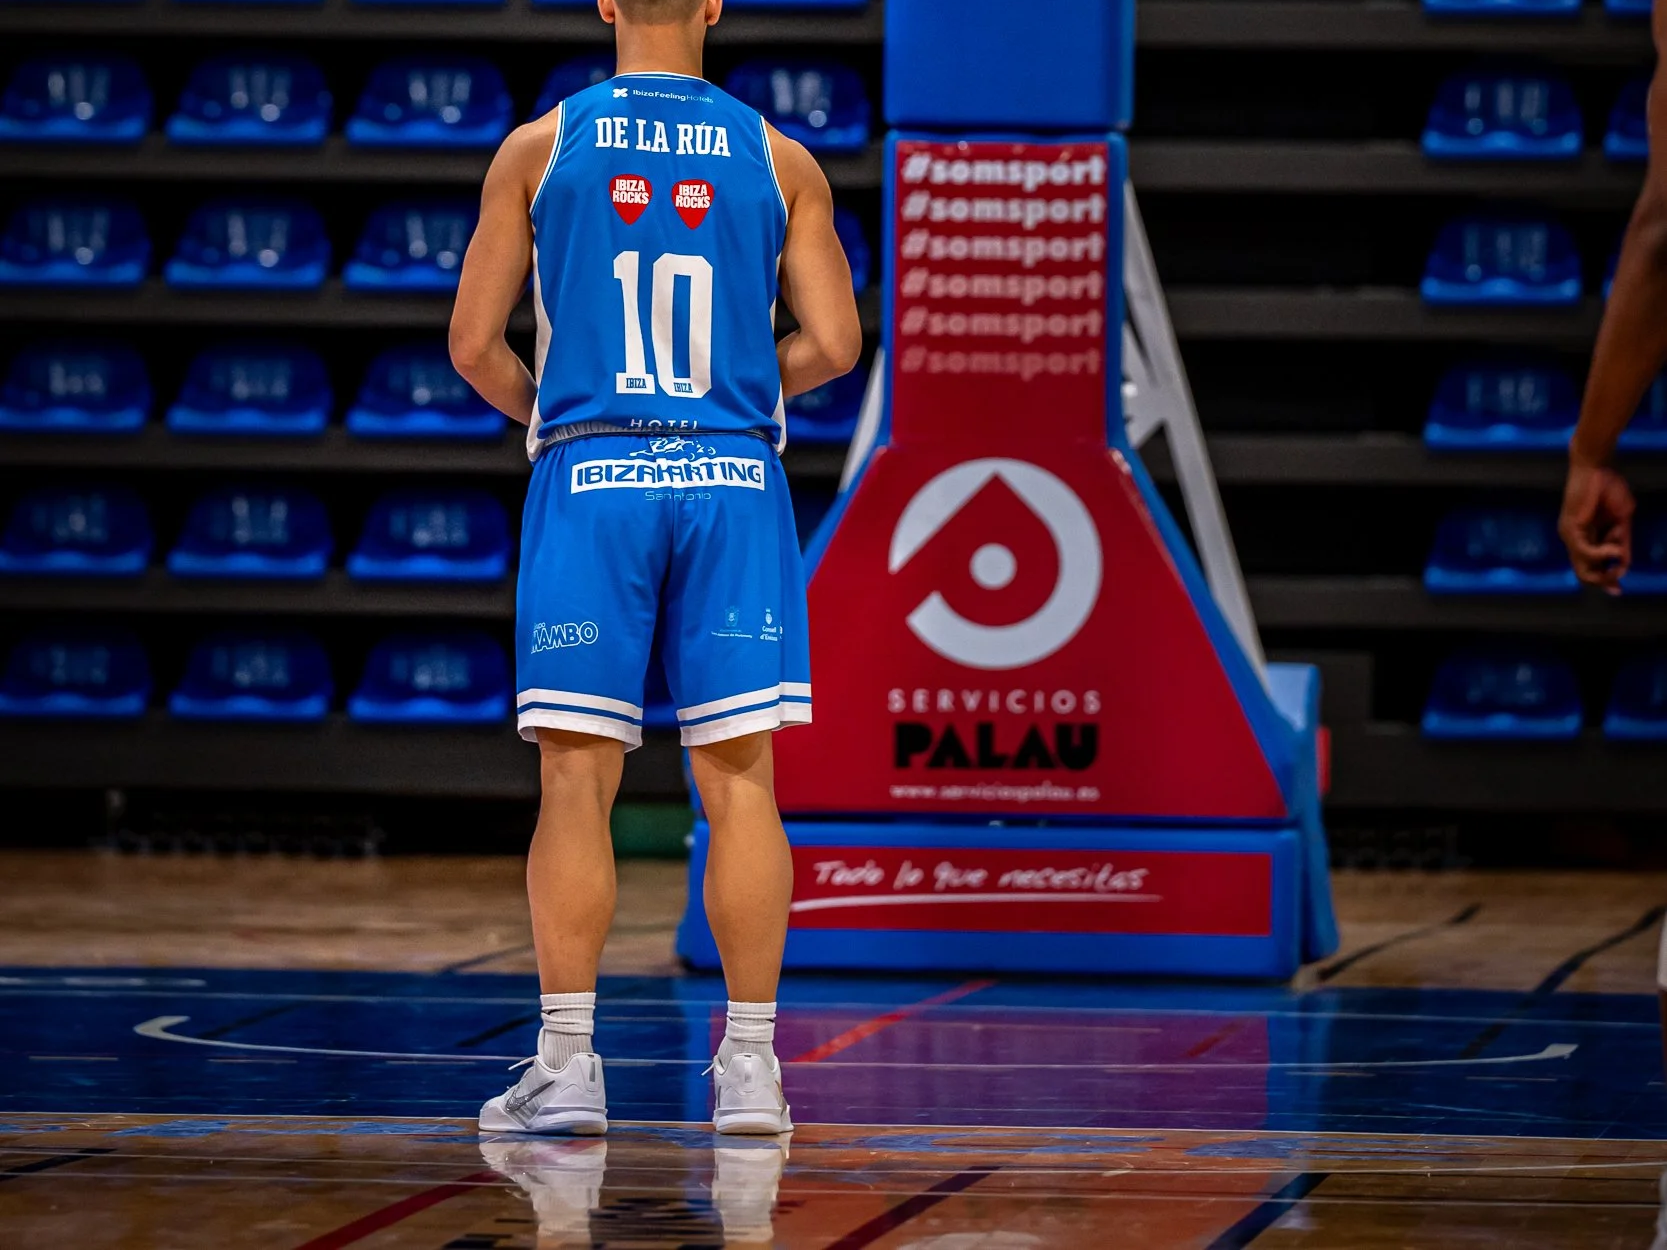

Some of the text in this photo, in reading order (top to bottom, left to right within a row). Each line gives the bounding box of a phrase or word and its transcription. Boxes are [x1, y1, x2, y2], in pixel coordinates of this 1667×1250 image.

[595, 117, 731, 157] DE LA RÚA
[615, 179, 646, 192] IBIZA
[678, 184, 707, 196] IBIZA
[902, 154, 1105, 192] #somsport
[612, 190, 649, 204] ROCKS
[675, 195, 711, 208] ROCKS
[902, 191, 1105, 230] #somsport
[901, 229, 1104, 268] #somsport
[901, 268, 1103, 306] #somsport
[613, 250, 713, 398] 10
[901, 306, 1102, 344] #somsport
[901, 346, 1100, 382] #somsport
[626, 378, 647, 389] IBIZA
[674, 382, 693, 393] IBIZA
[887, 687, 1101, 715] SERVICIOS
[894, 721, 1099, 771] PALAU
[813, 859, 884, 886] Todo
[893, 860, 924, 891] lo
